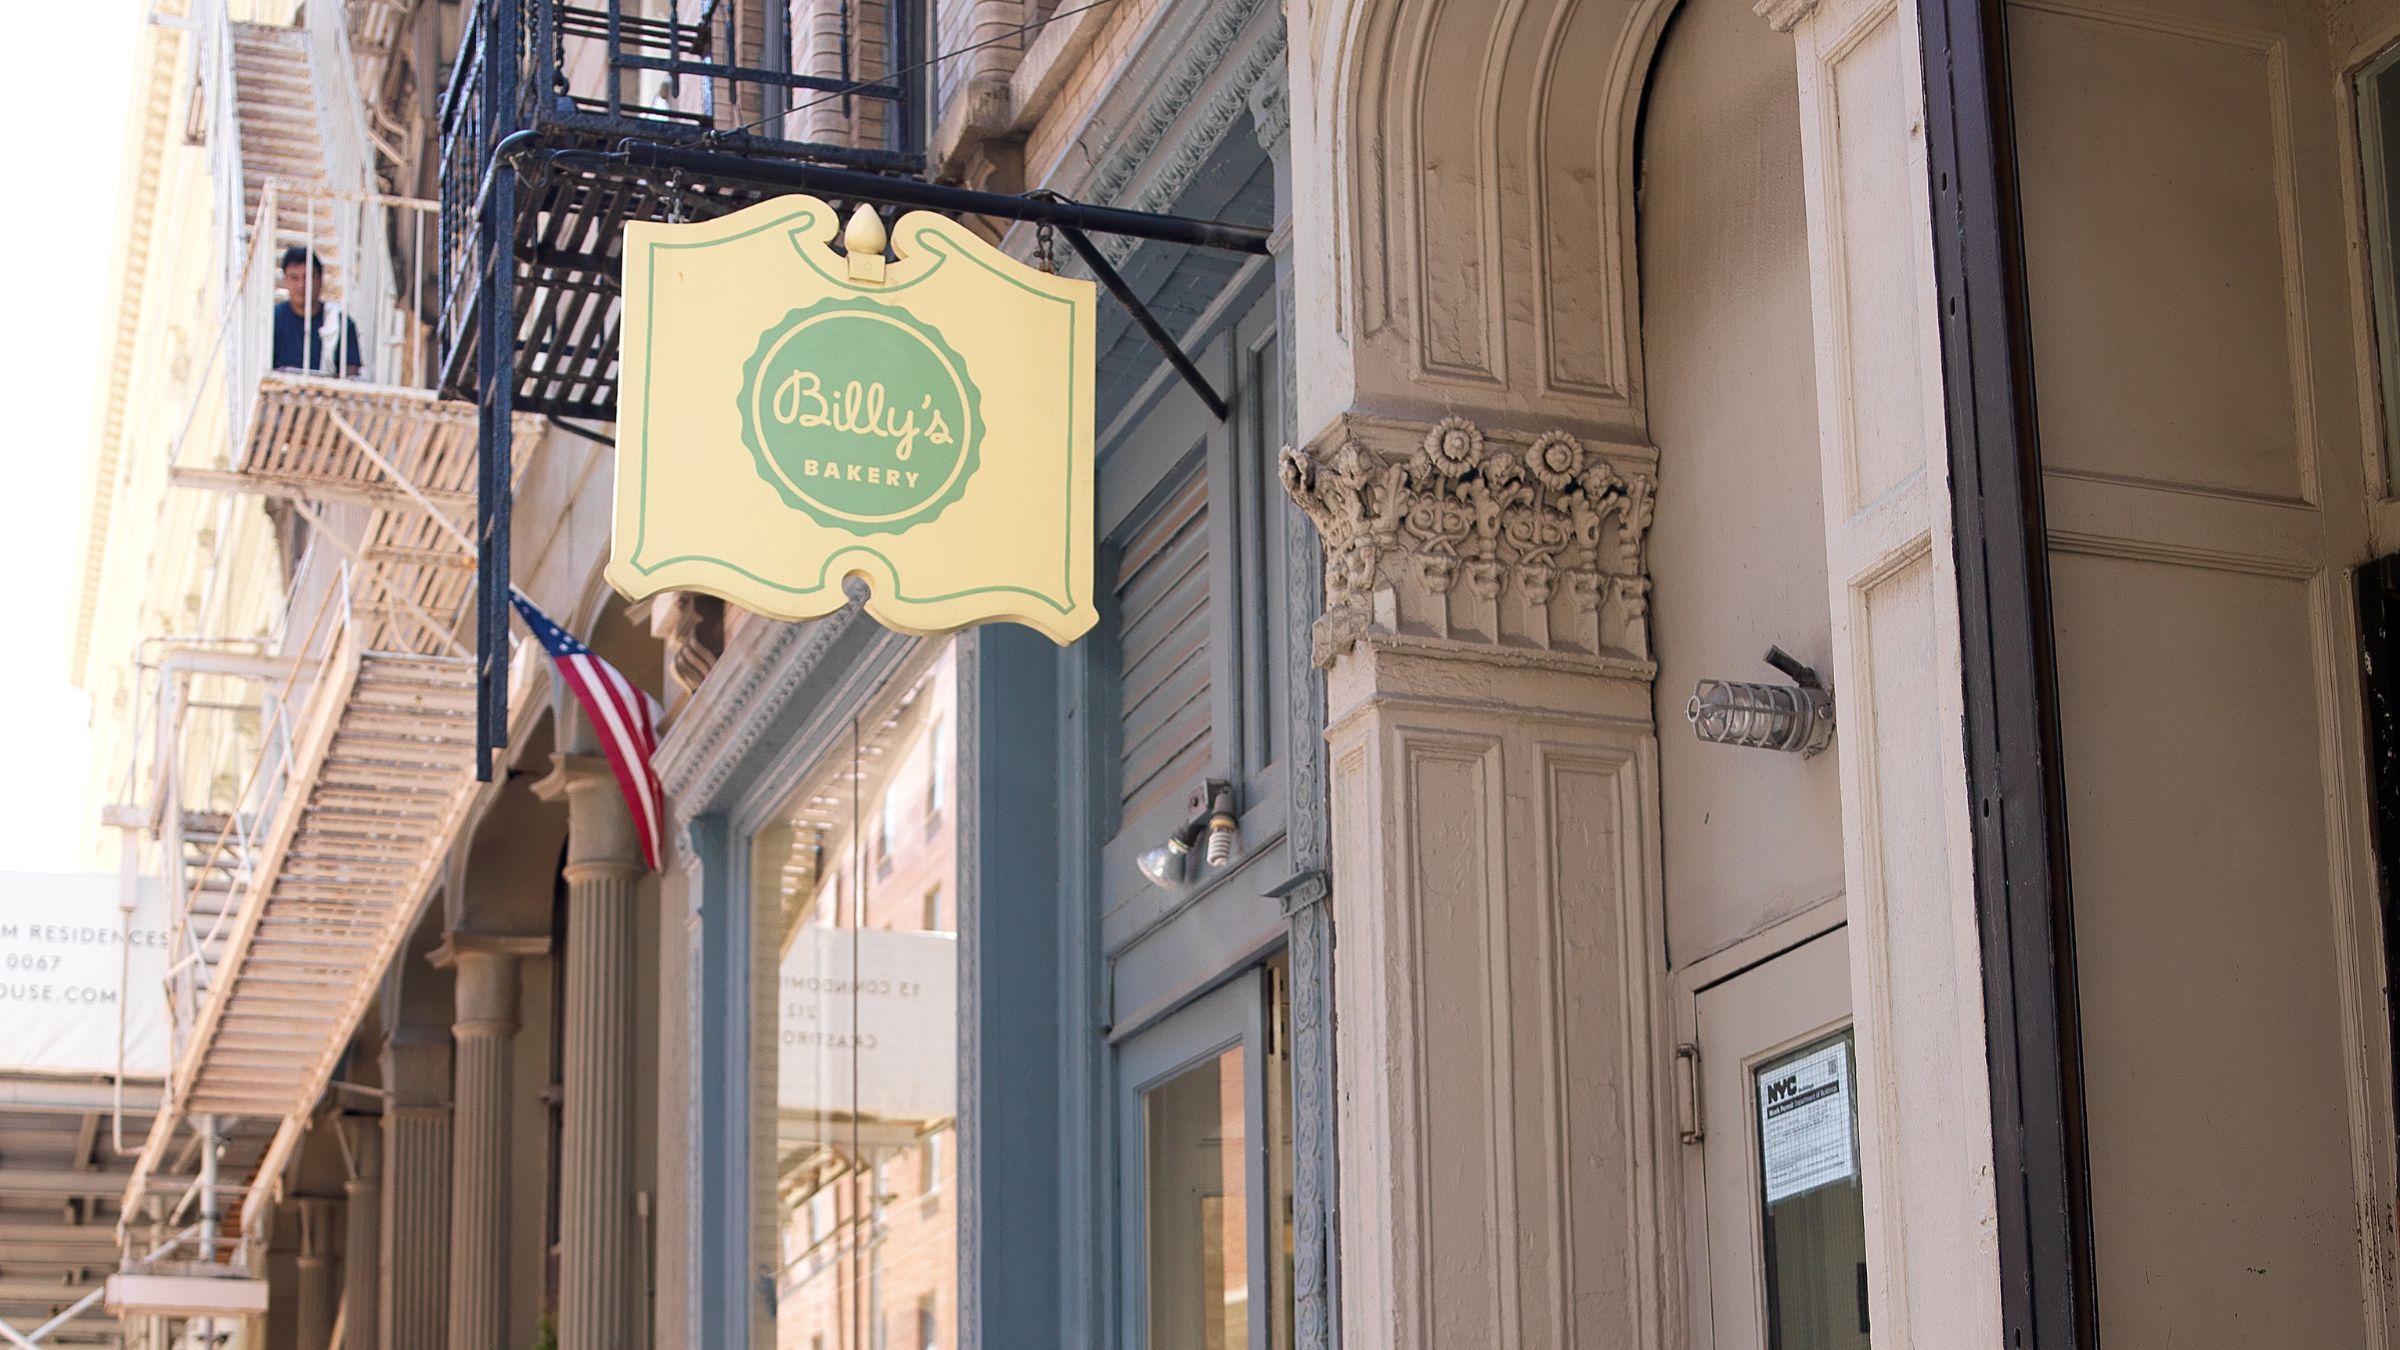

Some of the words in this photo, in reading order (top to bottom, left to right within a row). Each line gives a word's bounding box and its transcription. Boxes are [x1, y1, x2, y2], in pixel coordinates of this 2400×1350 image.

[773, 368, 954, 461] Billy's
[803, 459, 919, 488] BAKERY
[30, 924, 168, 949] RESIDENCES
[6, 953, 61, 971] 0067
[1767, 1075, 1797, 1104] NYC
